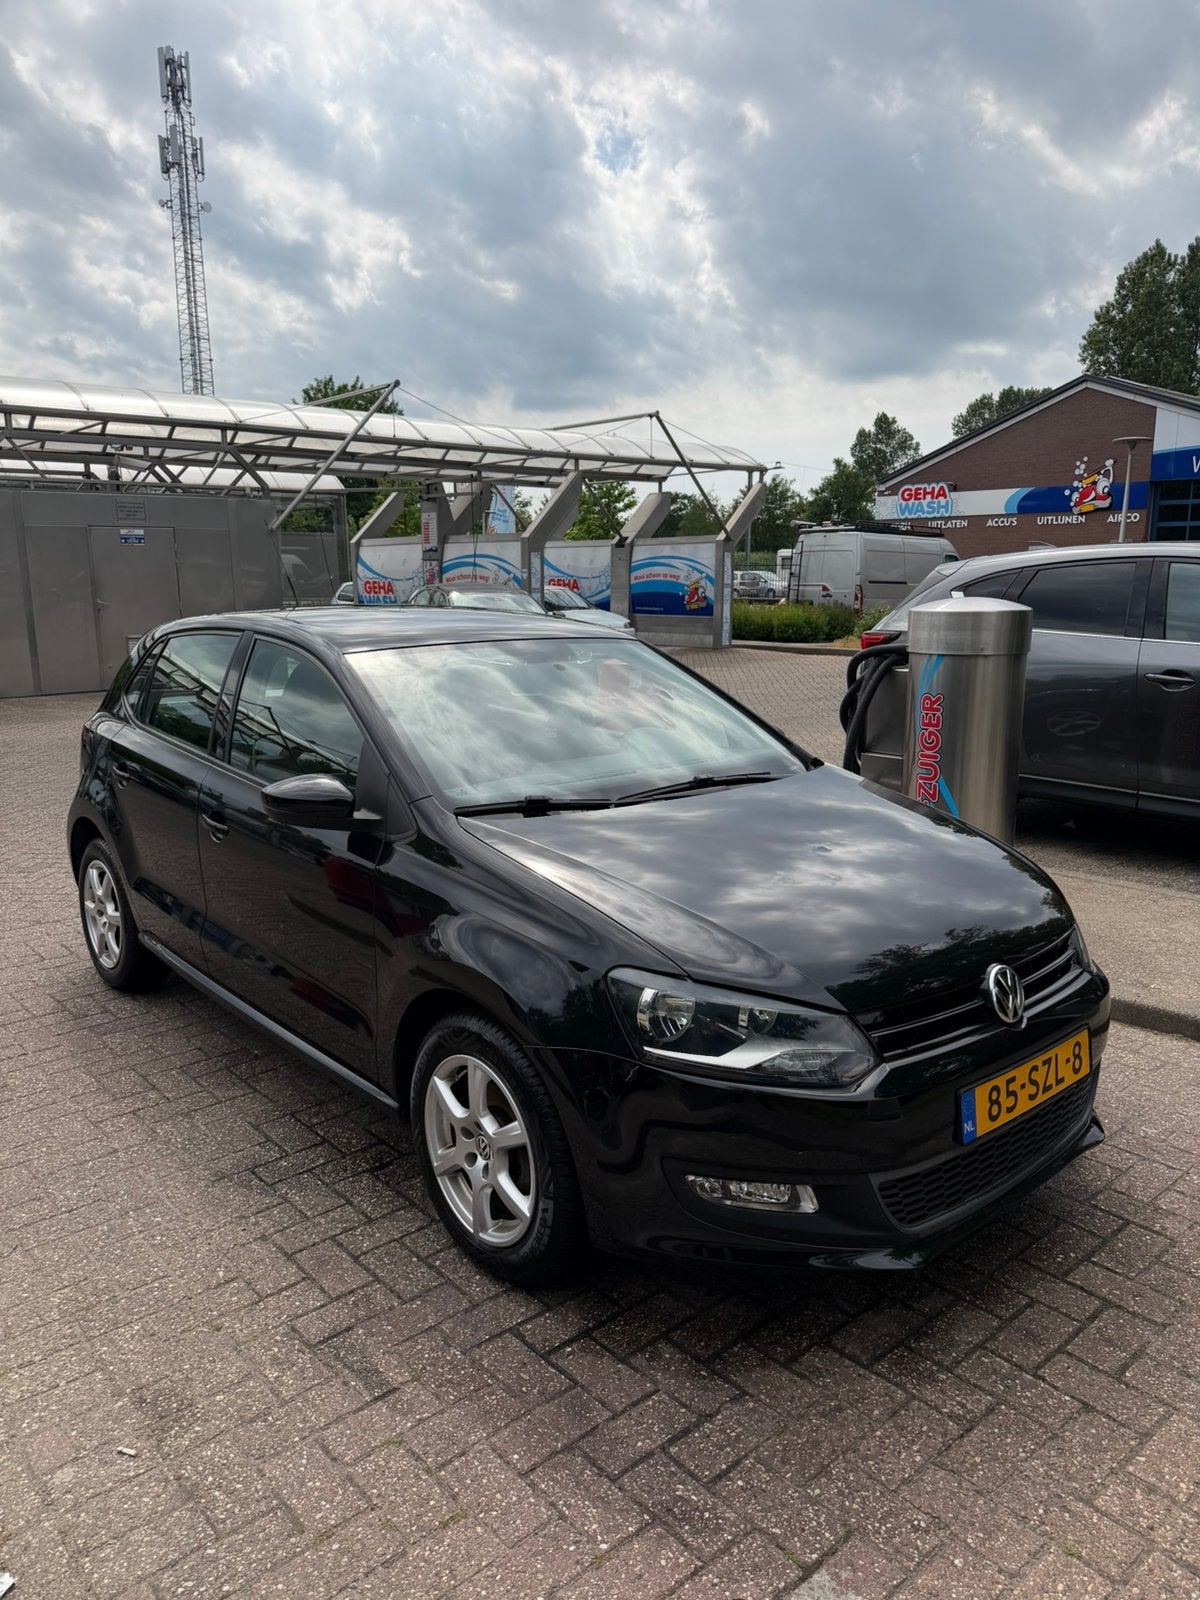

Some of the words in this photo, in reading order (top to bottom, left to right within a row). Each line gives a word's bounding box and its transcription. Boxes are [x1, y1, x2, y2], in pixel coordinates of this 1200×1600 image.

[900, 485, 947, 502] GEHA
[898, 500, 950, 516] WASH
[986, 517, 1018, 527] ACCU'S
[1037, 515, 1086, 526] UITLIJNEN
[1106, 512, 1140, 523] AIRCO
[364, 580, 395, 595] GEHA
[916, 694, 944, 804] ZUIGER
[987, 1040, 1083, 1122] 85-SZL-8
[964, 1120, 975, 1133] NL
